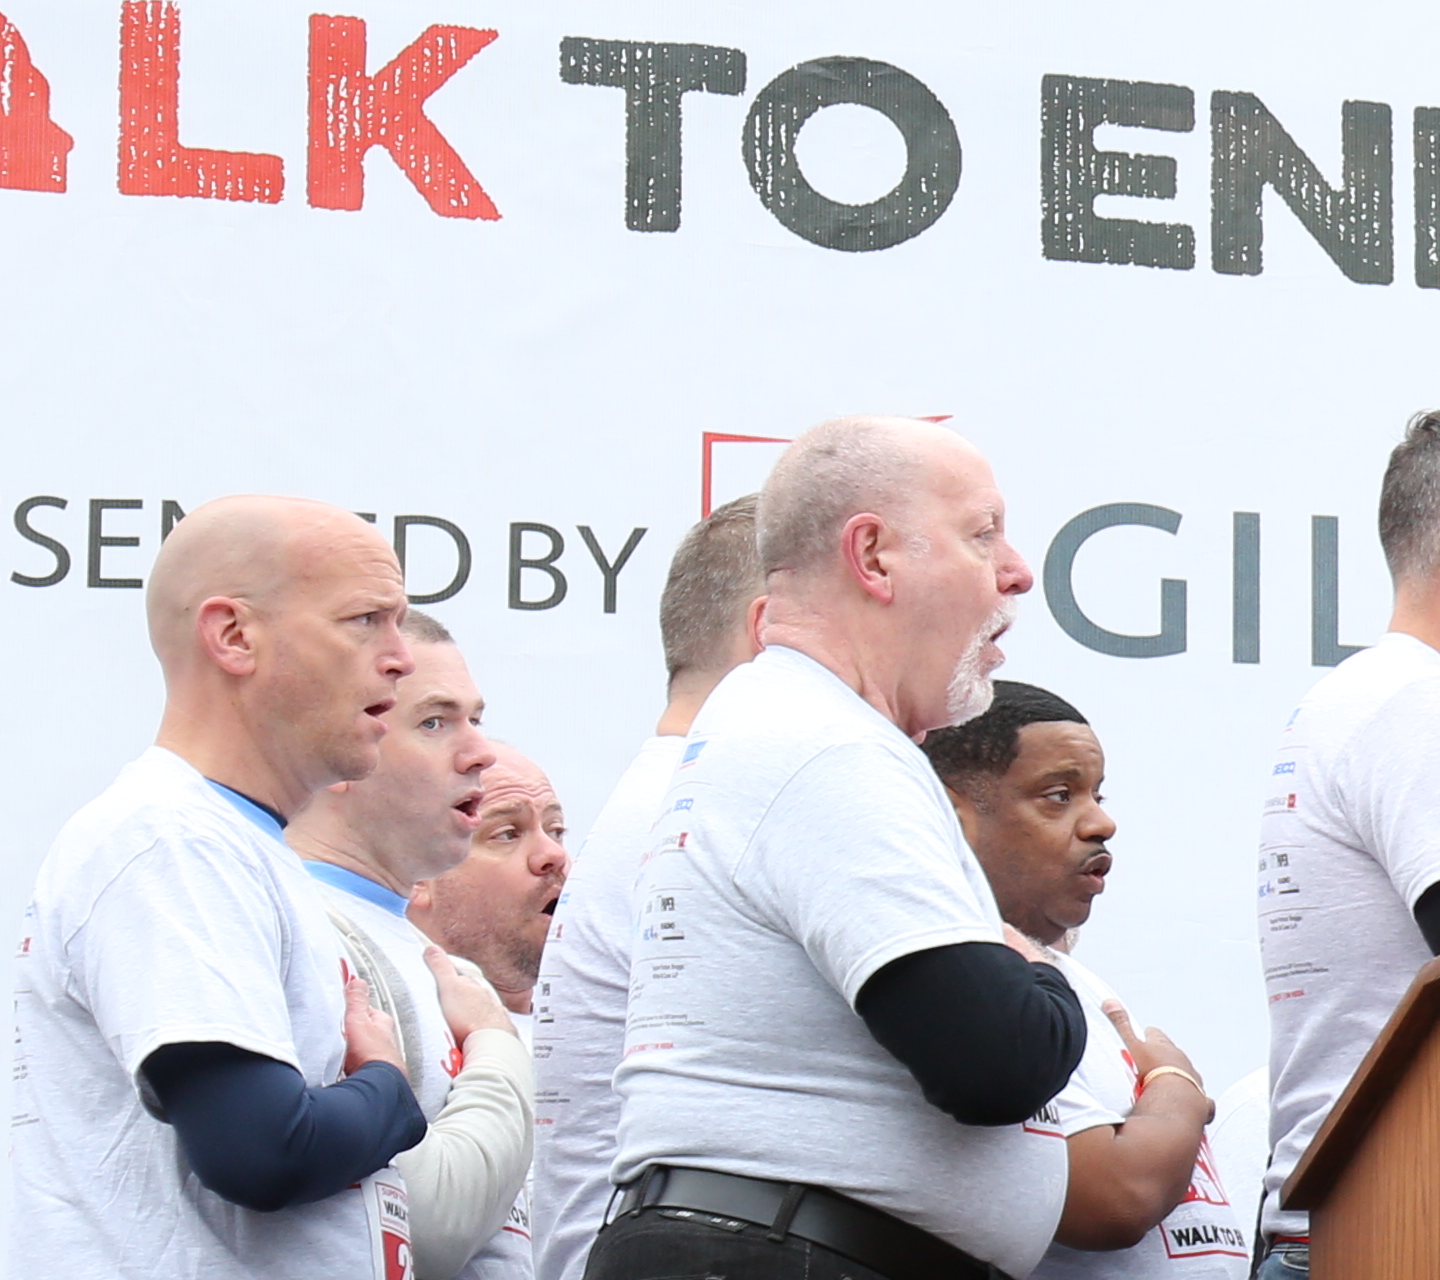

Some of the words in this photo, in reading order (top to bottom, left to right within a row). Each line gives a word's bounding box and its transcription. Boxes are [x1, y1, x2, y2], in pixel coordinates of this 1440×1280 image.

[559, 36, 963, 253] TO
[11, 494, 473, 606] SED
[508, 521, 648, 614] BY
[1171, 1224, 1222, 1248] WALK
[1219, 1227, 1236, 1247] TO
